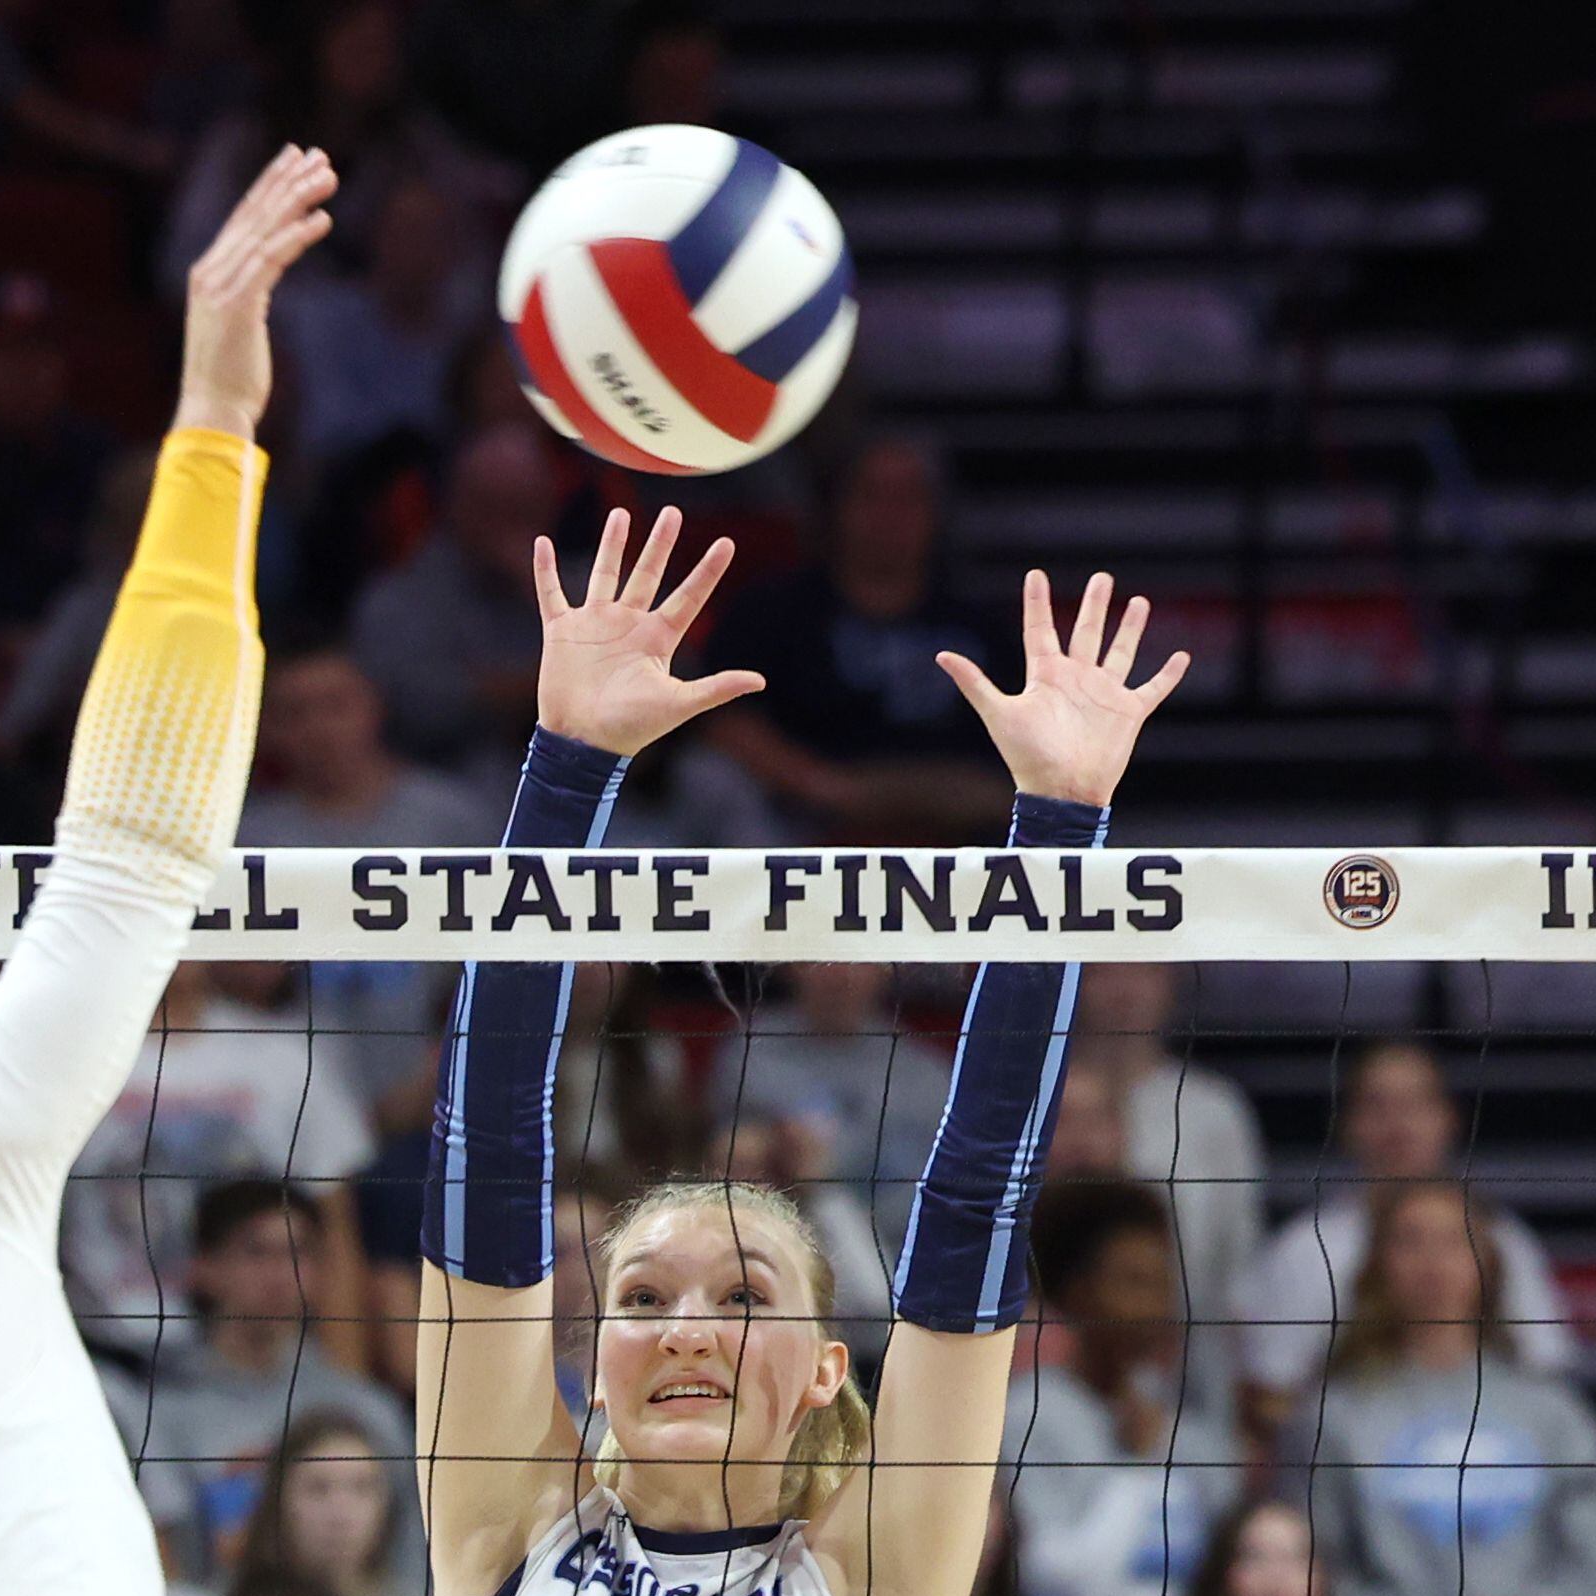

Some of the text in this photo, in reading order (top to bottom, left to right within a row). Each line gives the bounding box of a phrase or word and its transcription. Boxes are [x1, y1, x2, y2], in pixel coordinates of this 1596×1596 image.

[352, 855, 709, 931] STATE
[765, 855, 1182, 932] FINALS
[1343, 870, 1381, 897] 125
